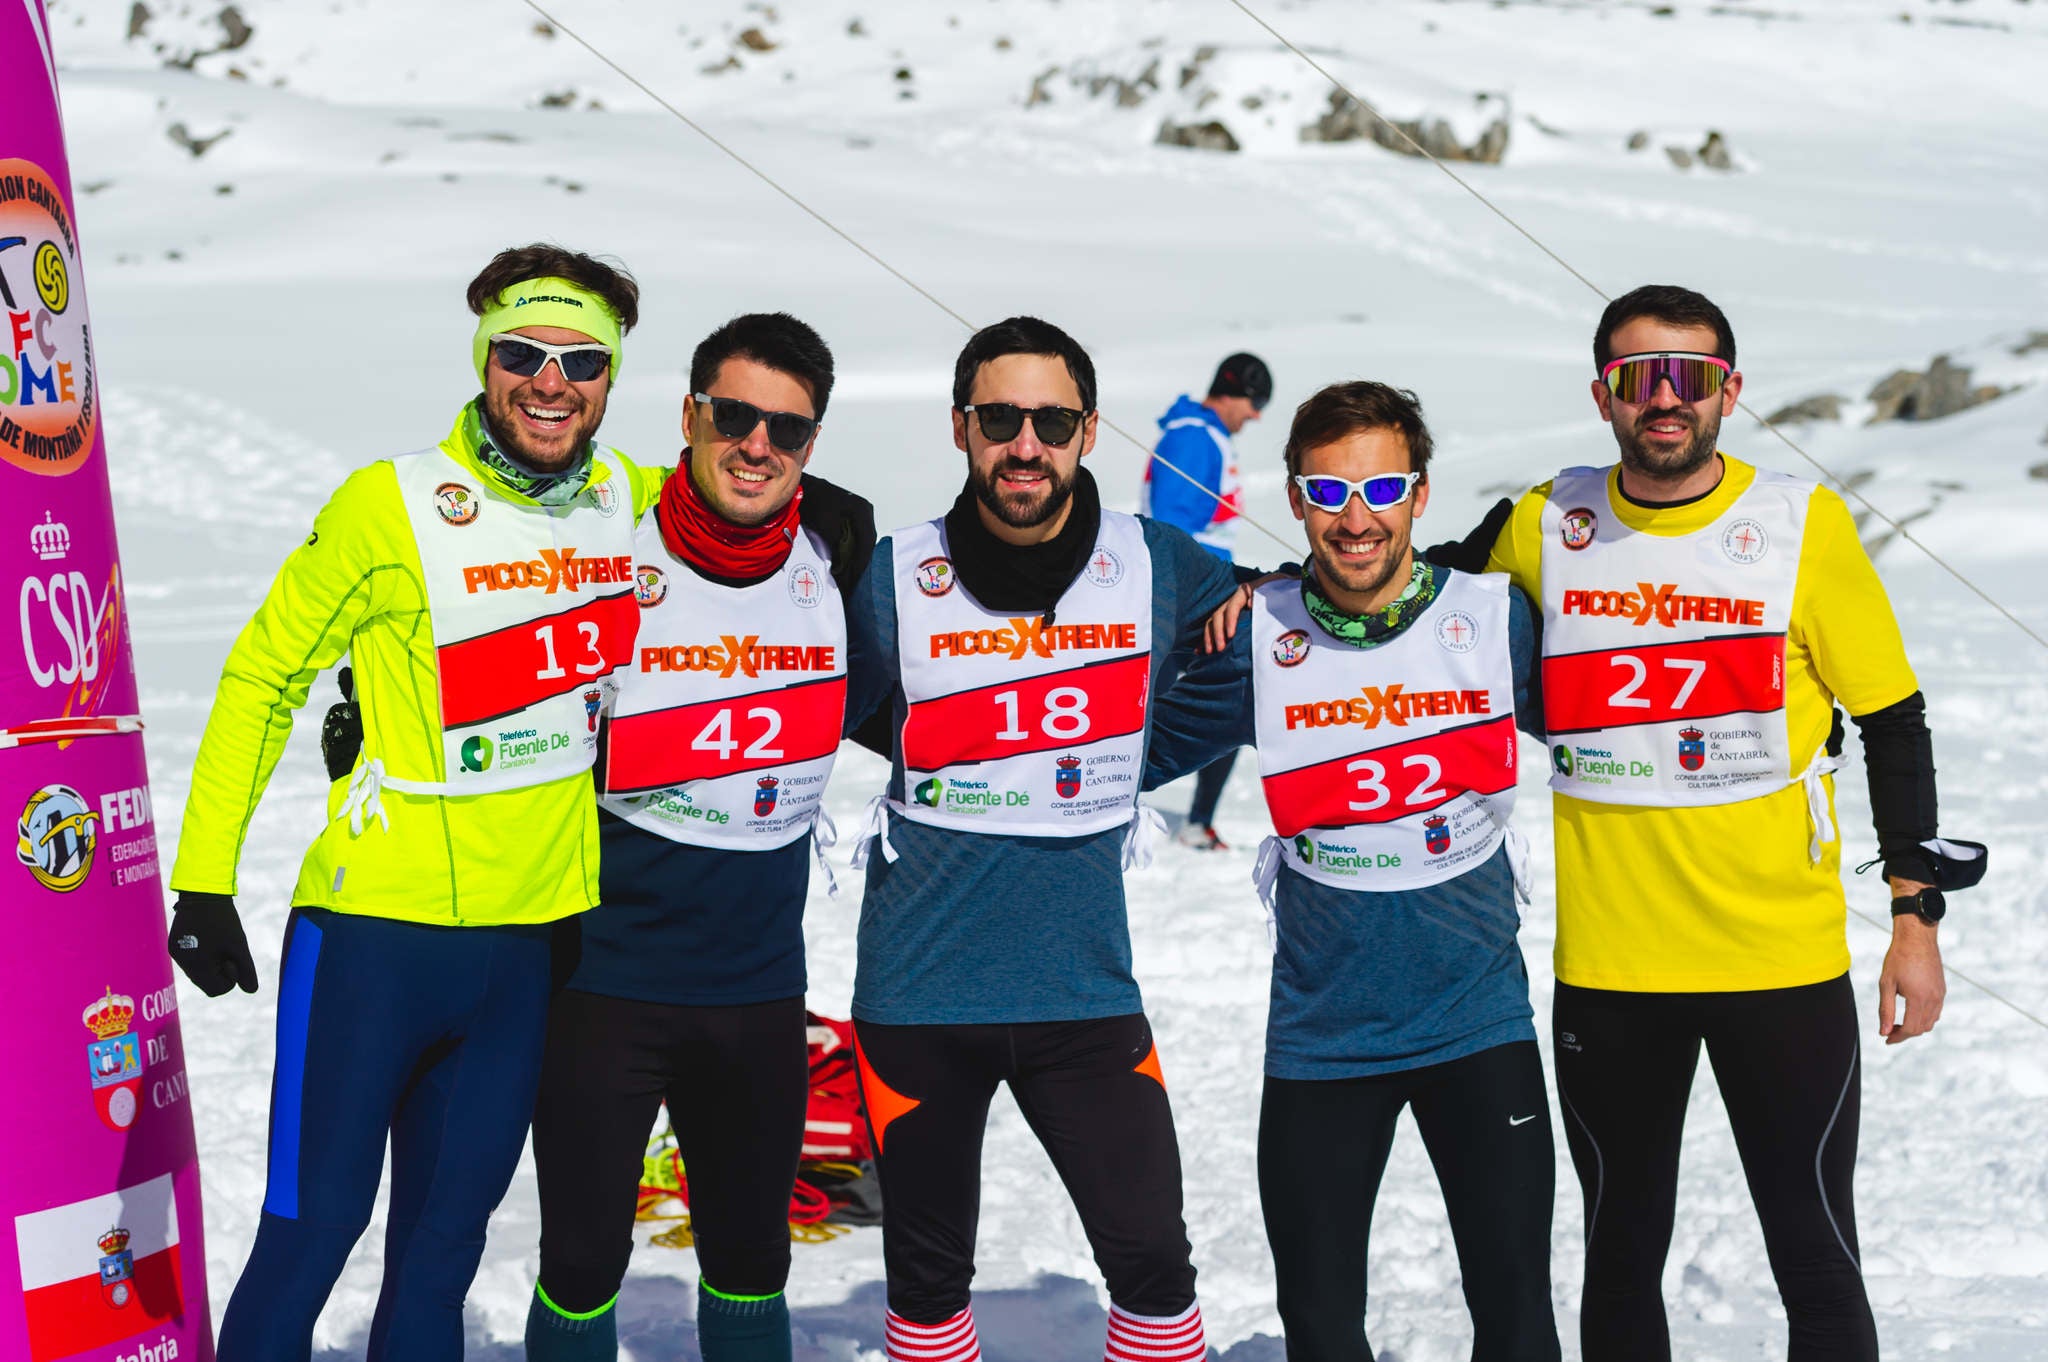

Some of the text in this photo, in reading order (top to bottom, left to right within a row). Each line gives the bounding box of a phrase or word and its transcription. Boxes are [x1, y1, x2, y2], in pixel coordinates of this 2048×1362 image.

[527, 295, 583, 308] FISCHER
[0, 416, 22, 449] DE
[22, 425, 83, 461] MONTAÑA
[1562, 582, 1766, 628] PICOSXTREME
[19, 570, 99, 688] CSD
[535, 621, 606, 680] 13
[640, 635, 835, 679] PICOSXTREME
[1607, 654, 1707, 710] 27
[994, 686, 1091, 741] 18
[1285, 684, 1491, 730] PICOSXTREME
[499, 729, 537, 741] Teleférico
[691, 707, 785, 760] 42
[1709, 730, 1762, 740] GOBIERNO
[499, 737, 549, 760] Fuente
[551, 731, 570, 750] Dé
[1576, 746, 1612, 759] Teleférico
[1710, 750, 1771, 761] CANTABRIA
[1086, 754, 1131, 766] GOBIERNO
[1576, 756, 1654, 777] Fuente Dé
[783, 775, 823, 787] GOBIERNO
[1086, 768, 1095, 776] de
[1086, 773, 1132, 787] CANTABRIA
[1346, 754, 1446, 811] 32
[948, 778, 989, 789] Teleférico
[647, 791, 730, 825] Fuente Dé
[946, 788, 1030, 807] Fuente Dé
[1317, 840, 1357, 854] Teleférico
[1317, 850, 1402, 868] Fuente Dé
[147, 1034, 169, 1067] DE
